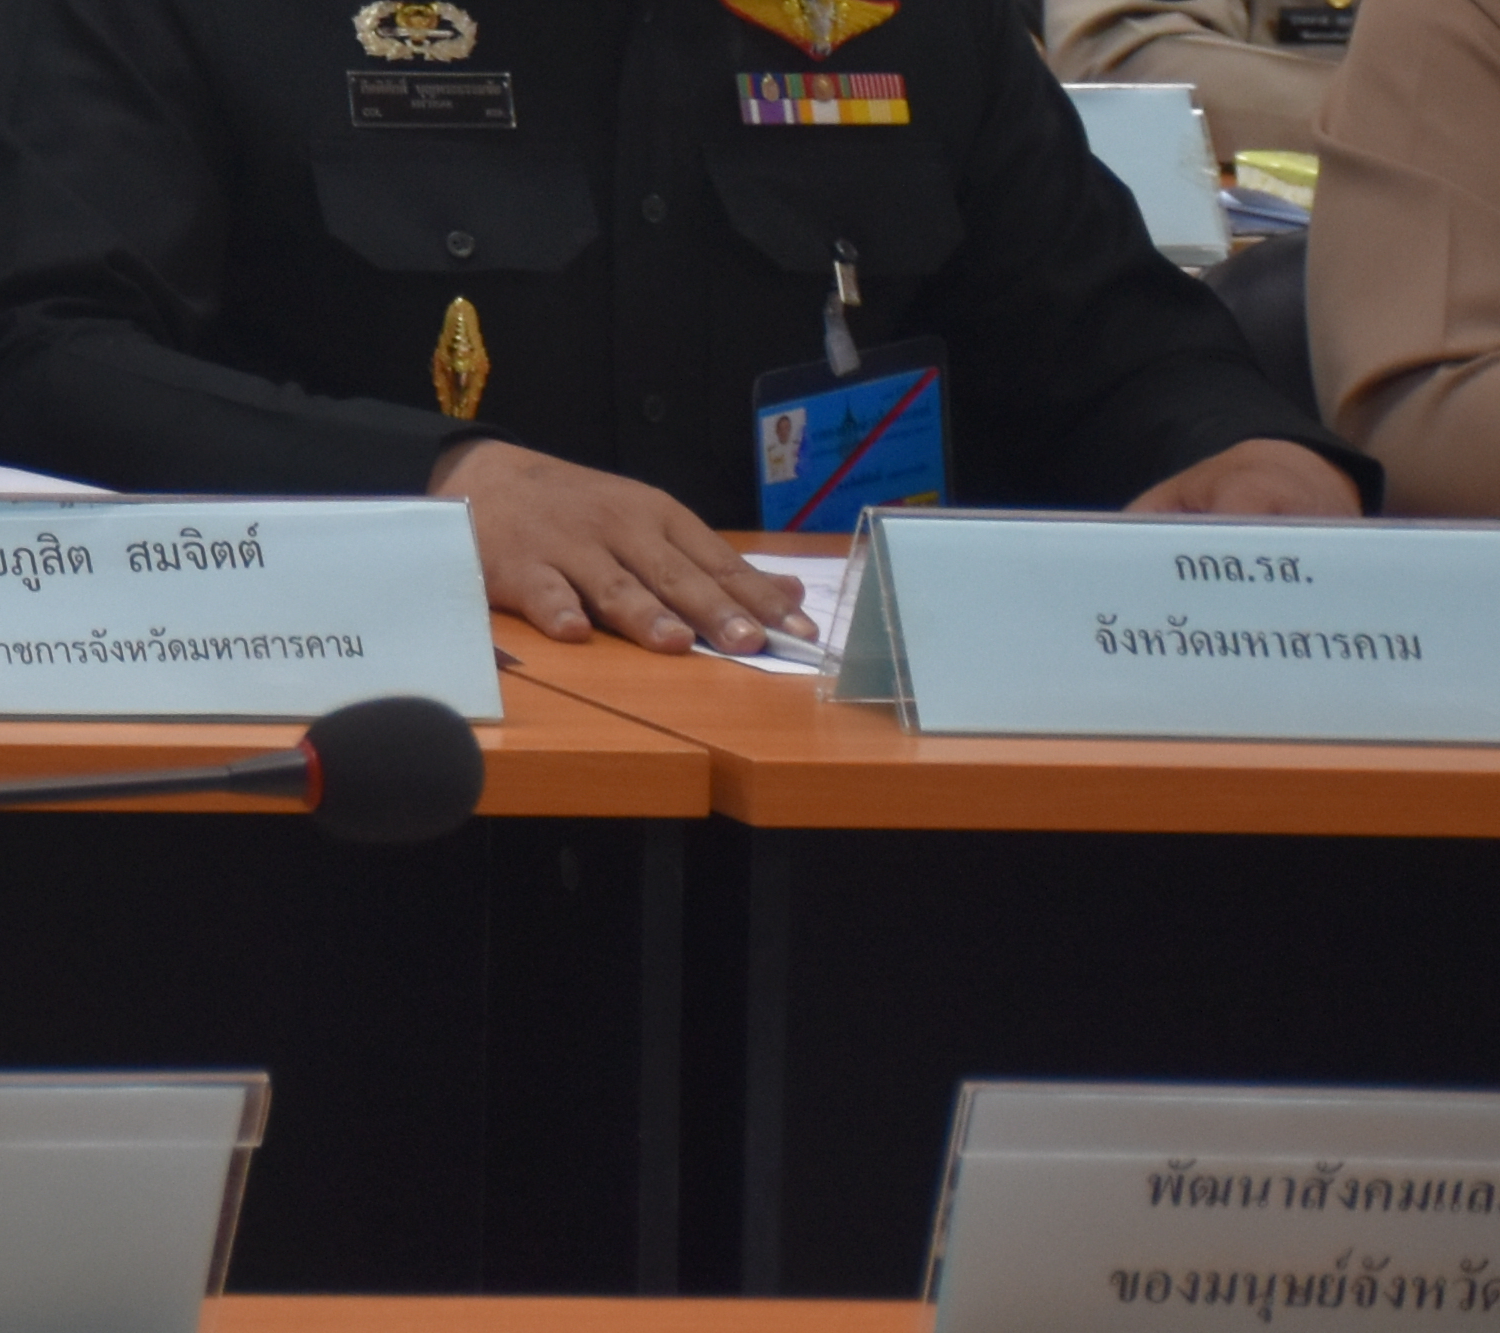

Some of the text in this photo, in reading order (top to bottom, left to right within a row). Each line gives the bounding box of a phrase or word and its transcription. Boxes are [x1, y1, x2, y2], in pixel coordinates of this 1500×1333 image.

[125, 522, 266, 574] สมจิตต์
[1174, 554, 1314, 584] กกล.รส.
[1095, 613, 1423, 661] จังหวัดมหาสารคาม
[1148, 1158, 1500, 1214] พัฒนาสังคมแล
